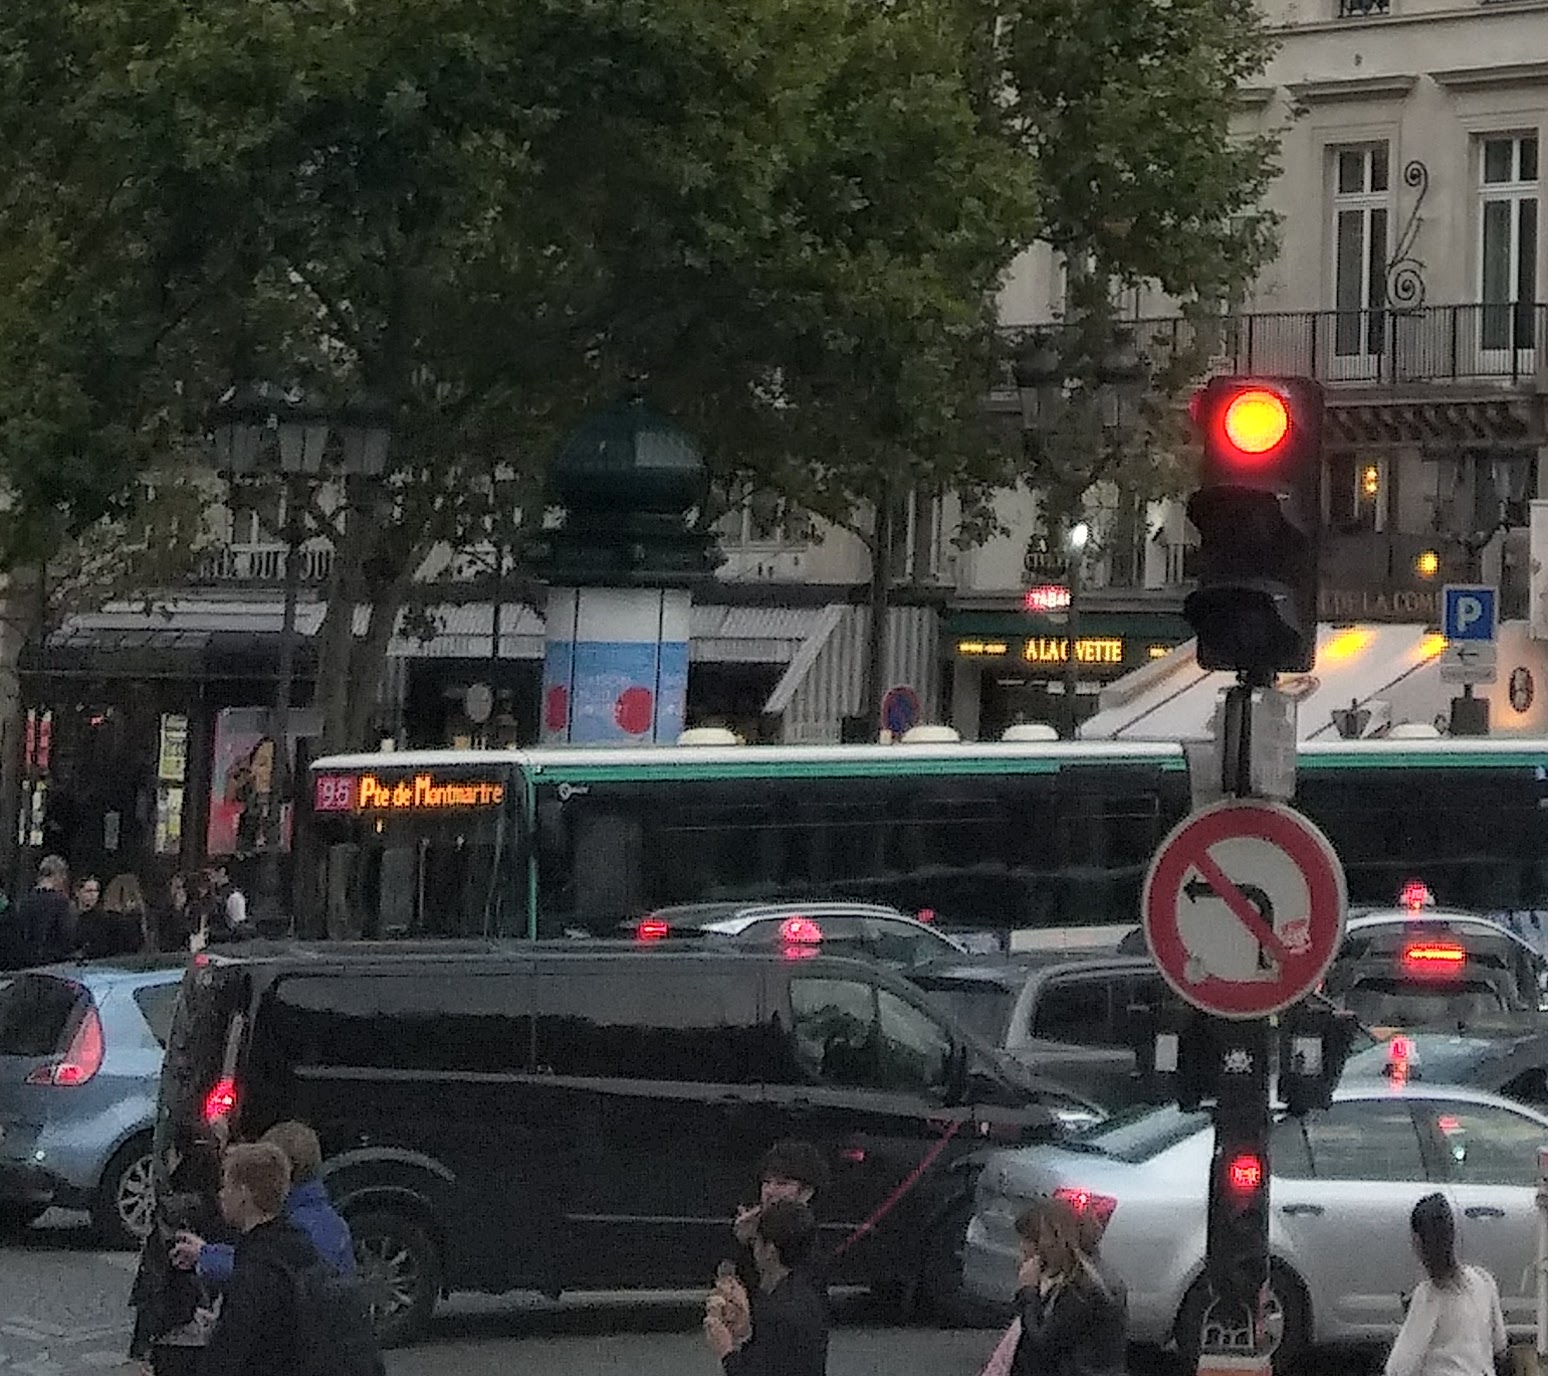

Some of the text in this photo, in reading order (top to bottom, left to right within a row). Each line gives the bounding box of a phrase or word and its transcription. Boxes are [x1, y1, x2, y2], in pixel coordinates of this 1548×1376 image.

[1457, 596, 1483, 632] P
[1060, 639, 1122, 662] CVETTE
[360, 775, 390, 807] Pte
[392, 779, 412, 806] de
[414, 774, 504, 806] Montmartre
